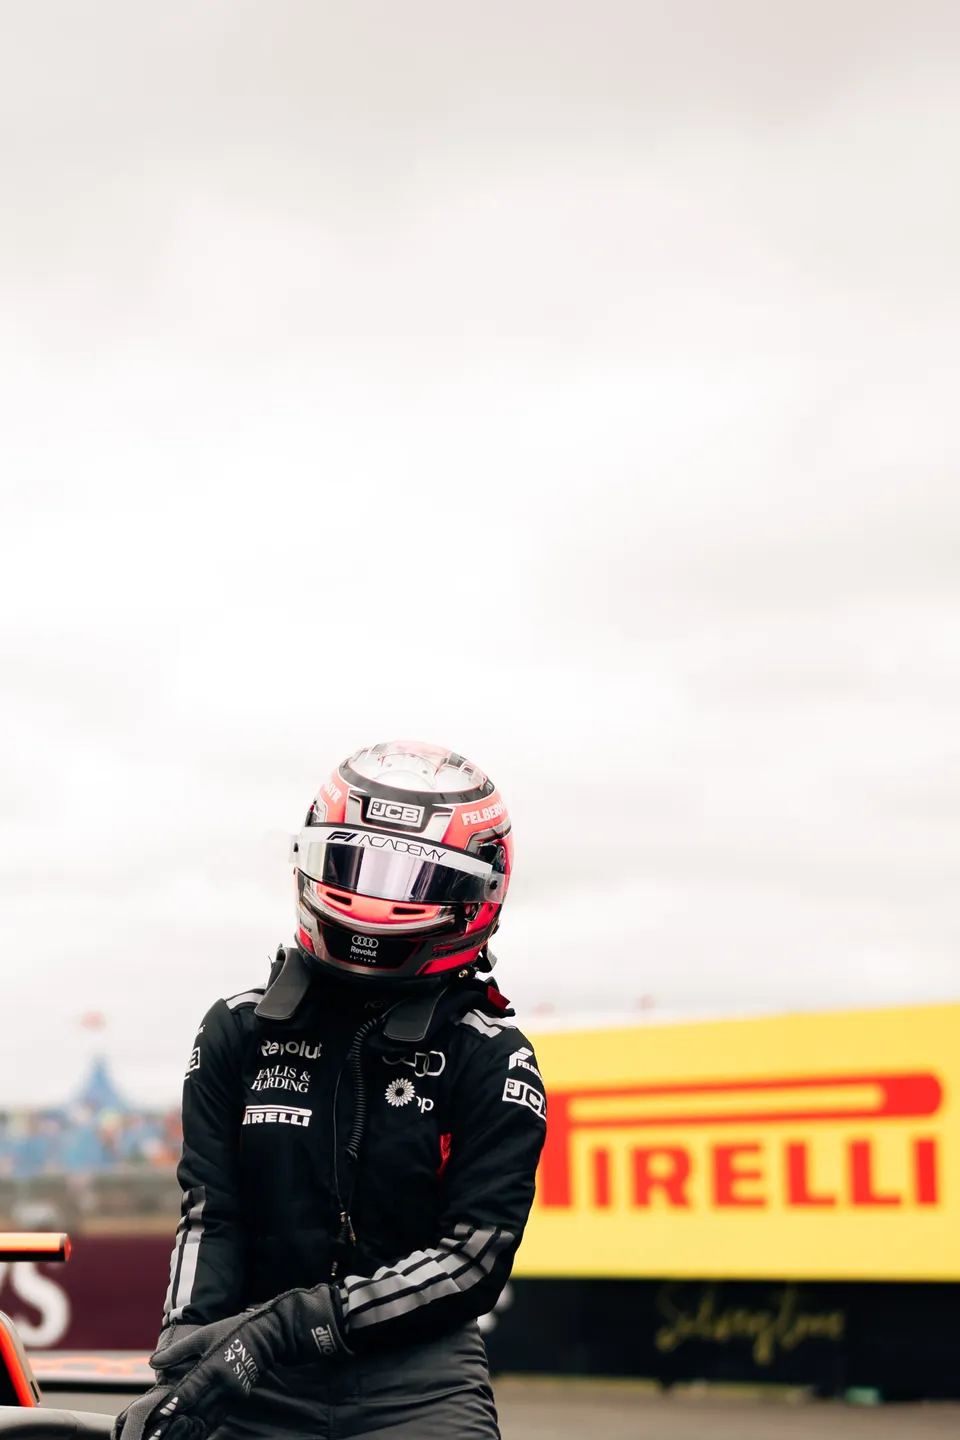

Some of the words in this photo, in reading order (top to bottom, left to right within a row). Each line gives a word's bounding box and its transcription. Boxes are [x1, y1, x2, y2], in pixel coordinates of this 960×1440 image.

[371, 800, 419, 823] JCB
[359, 835, 446, 862] ACADEMY
[350, 945, 377, 957] Revolut
[300, 1070, 311, 1082] &
[541, 1071, 944, 1210] PIRELLI
